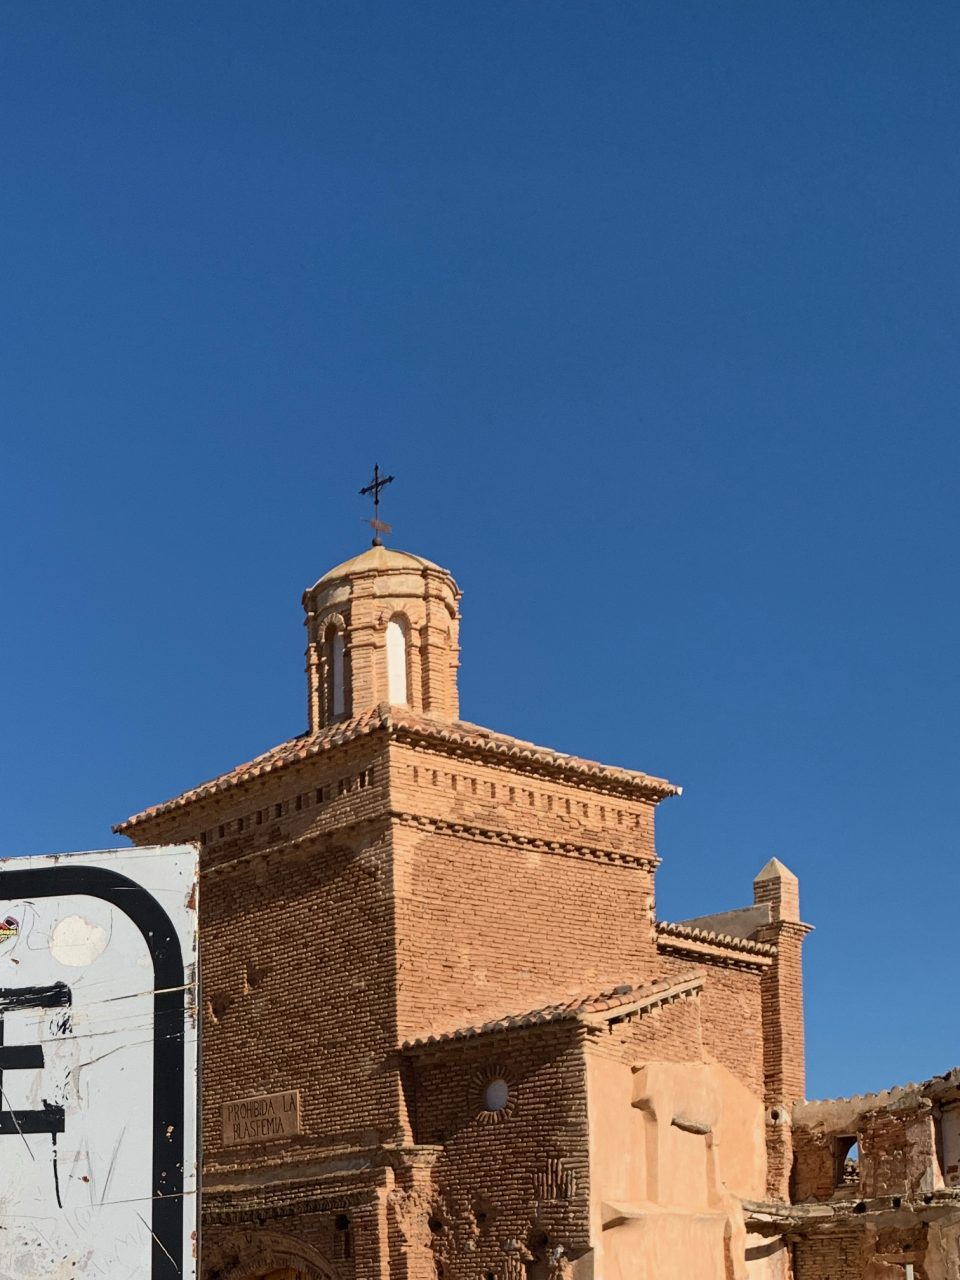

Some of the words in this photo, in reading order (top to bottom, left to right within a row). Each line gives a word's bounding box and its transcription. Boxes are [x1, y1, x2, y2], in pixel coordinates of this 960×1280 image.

[227, 1098, 275, 1122] PROHIBIDA
[282, 1094, 296, 1113] LA
[232, 1117, 285, 1141] BLASFEMIA
